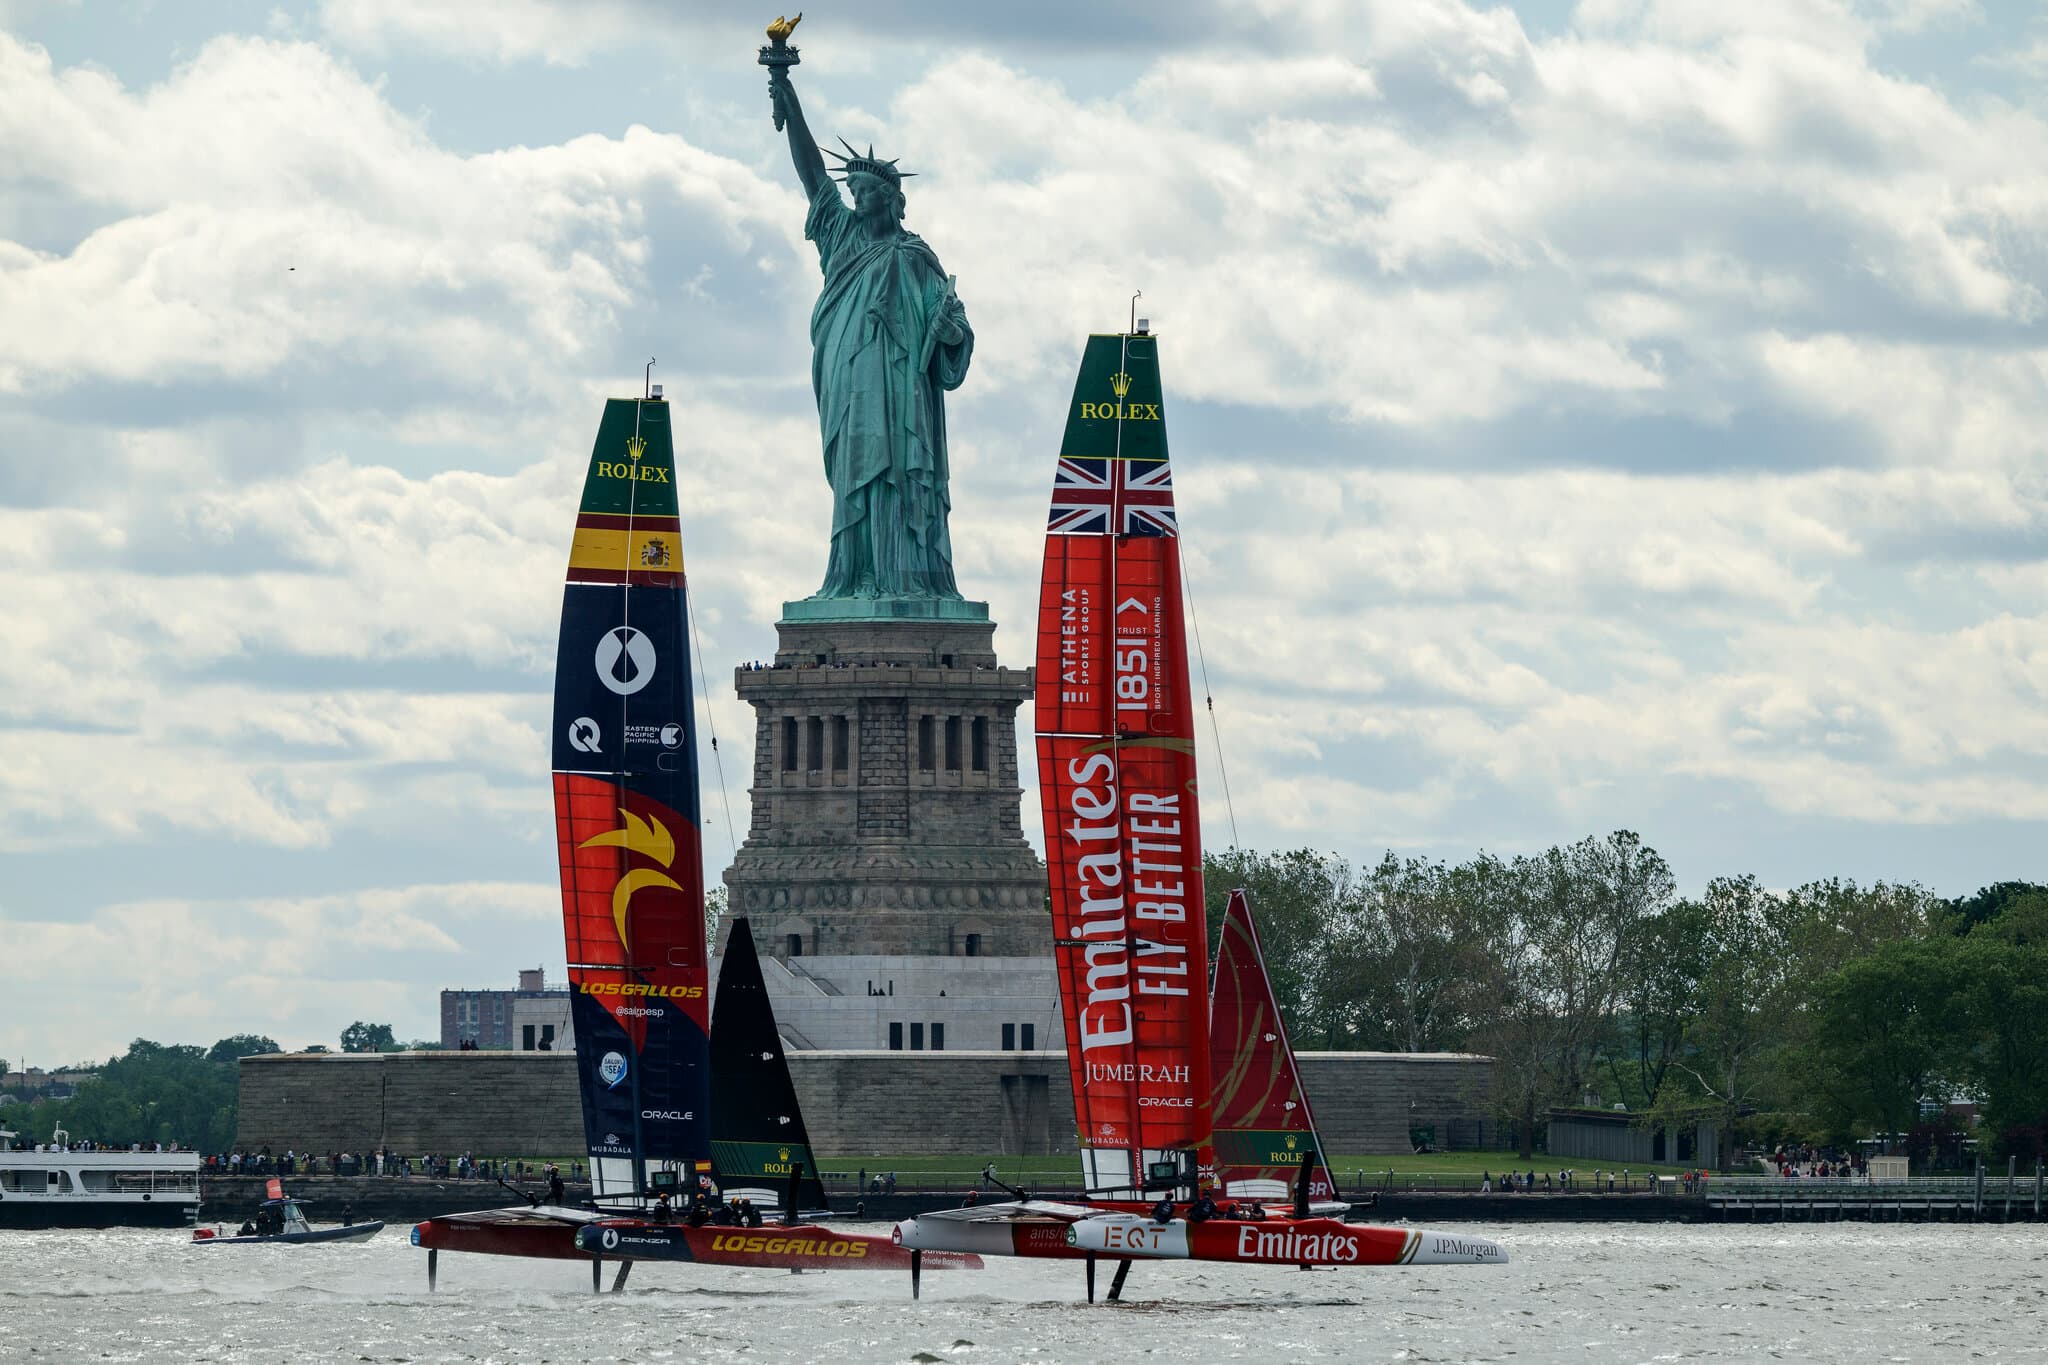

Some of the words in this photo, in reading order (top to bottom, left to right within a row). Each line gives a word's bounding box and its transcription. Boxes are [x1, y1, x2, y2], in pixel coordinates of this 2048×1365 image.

[1080, 403, 1160, 420] ROLEX
[597, 462, 669, 483] ROLEX
[1081, 589, 1089, 632] GROUP
[1153, 596, 1161, 638] LEARNING
[1062, 589, 1076, 684] ATHENA
[1081, 638, 1089, 685] SPORTS
[1117, 639, 1148, 710] 1851
[1129, 793, 1186, 922] BETTER
[1064, 753, 1133, 1053] Emirates
[1135, 938, 1189, 996] FLY
[580, 982, 703, 998] LOSGALLOS
[608, 1065, 621, 1074] SEA
[1083, 1061, 1190, 1087] JUMERAH
[1138, 1097, 1194, 1107] ORACLE
[641, 1110, 693, 1120] ORACLE
[591, 1145, 632, 1153] MUBADALA
[1085, 1137, 1130, 1145] MUBADALA
[1270, 1152, 1304, 1162] ROLE
[621, 1236, 671, 1244] DENZA
[712, 1235, 869, 1258] LOSGALLOS
[1104, 1226, 1166, 1248] EQT
[1238, 1225, 1359, 1262] Emirates
[921, 1256, 941, 1265] Private
[1433, 1239, 1498, 1261] J.P.Morgan
